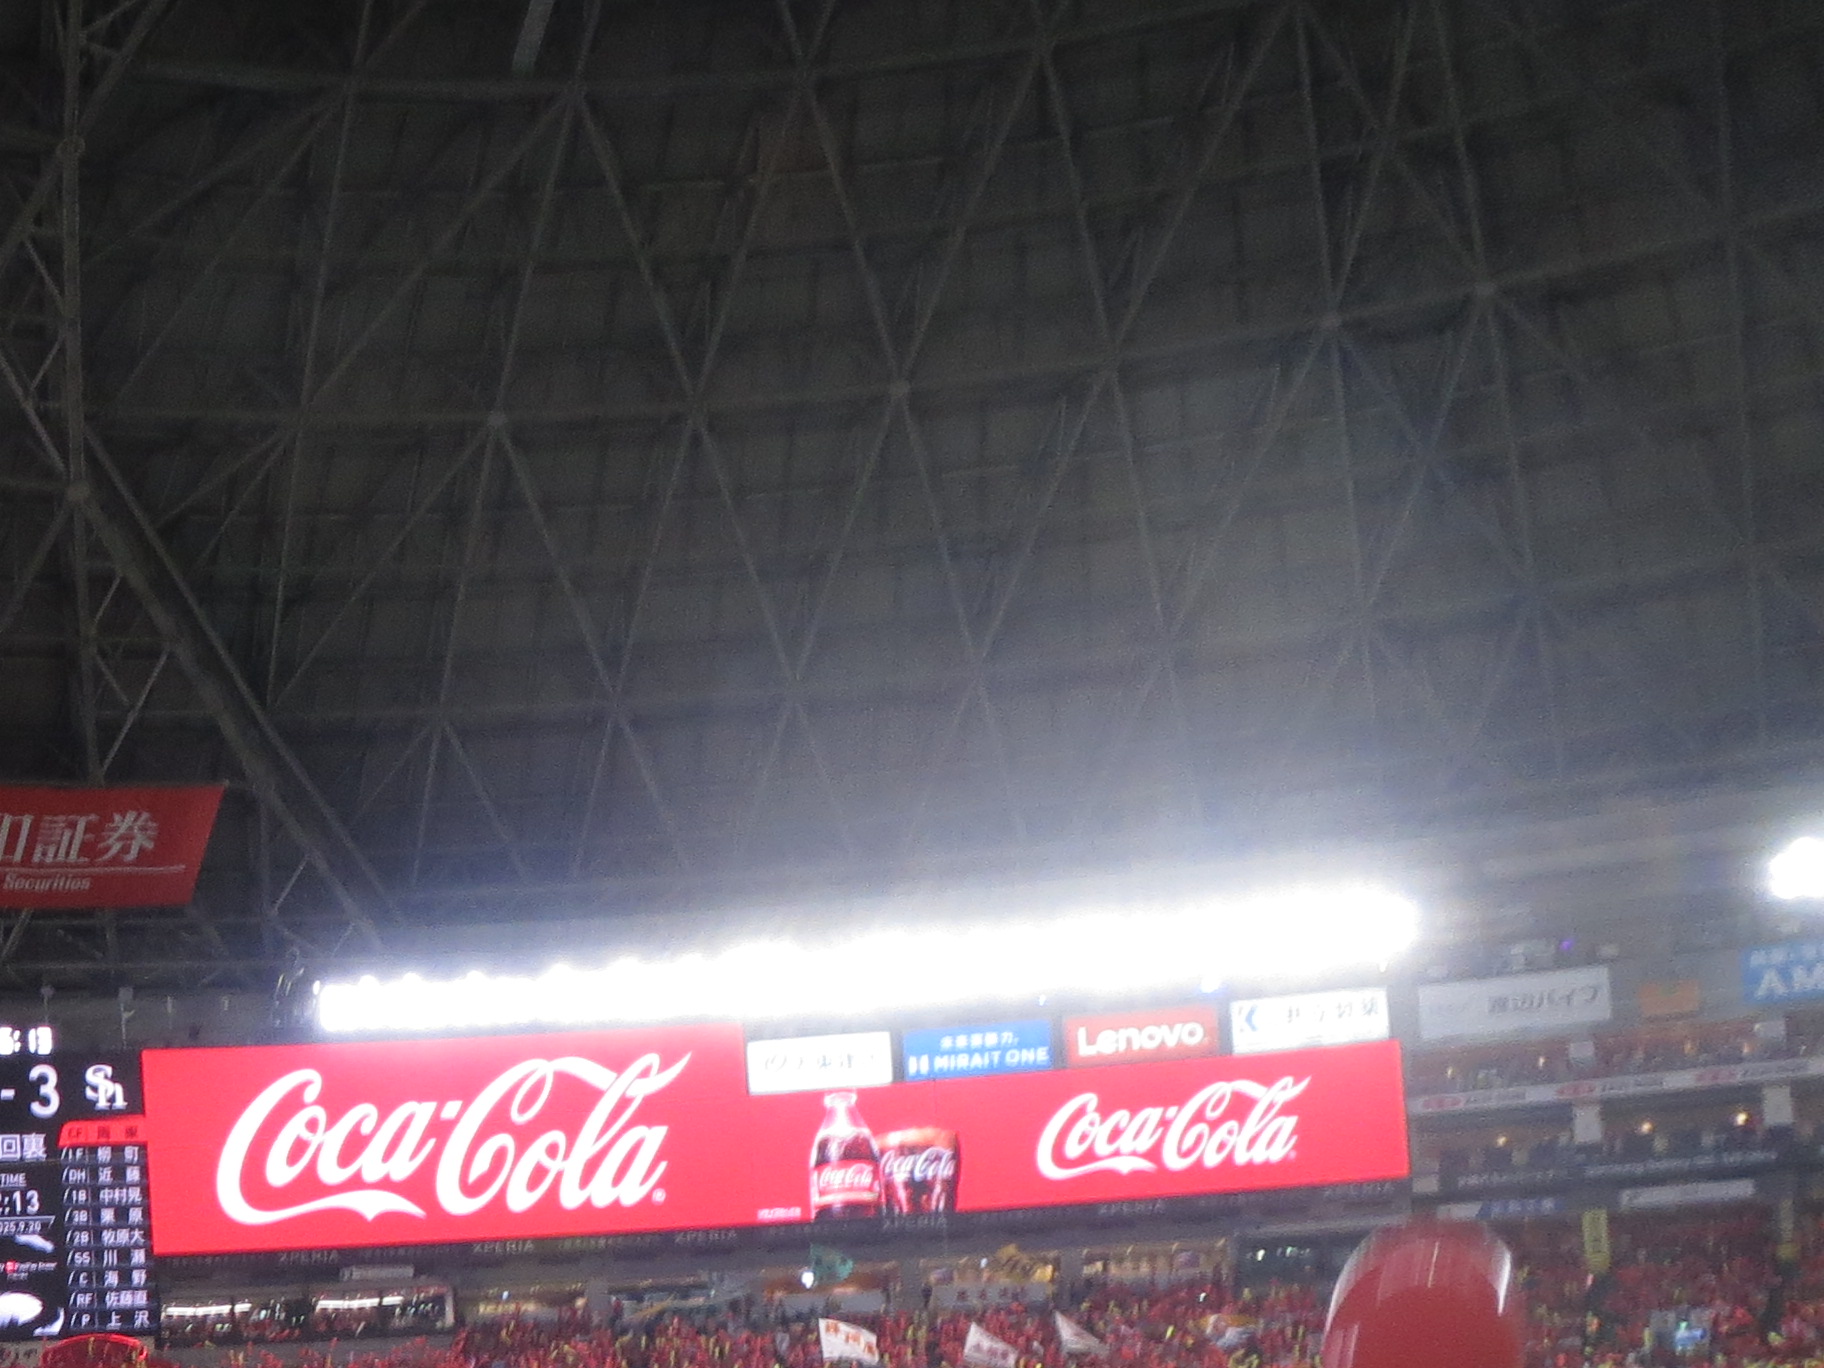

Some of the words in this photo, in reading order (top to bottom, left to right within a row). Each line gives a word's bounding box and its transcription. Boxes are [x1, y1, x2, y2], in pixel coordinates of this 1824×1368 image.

[2, 872, 91, 893] Securities
[1077, 1021, 1205, 1056] Lenovo
[933, 1050, 1001, 1073] MIRAIT
[1004, 1046, 1050, 1067] ONE
[29, 1064, 60, 1119] 3
[216, 1051, 692, 1225] Coca-Cola
[1037, 1075, 1312, 1180] Coca-Cola
[0, 1173, 27, 1188] TIME
[69, 1169, 86, 1184] DH
[72, 1189, 87, 1205] 1B
